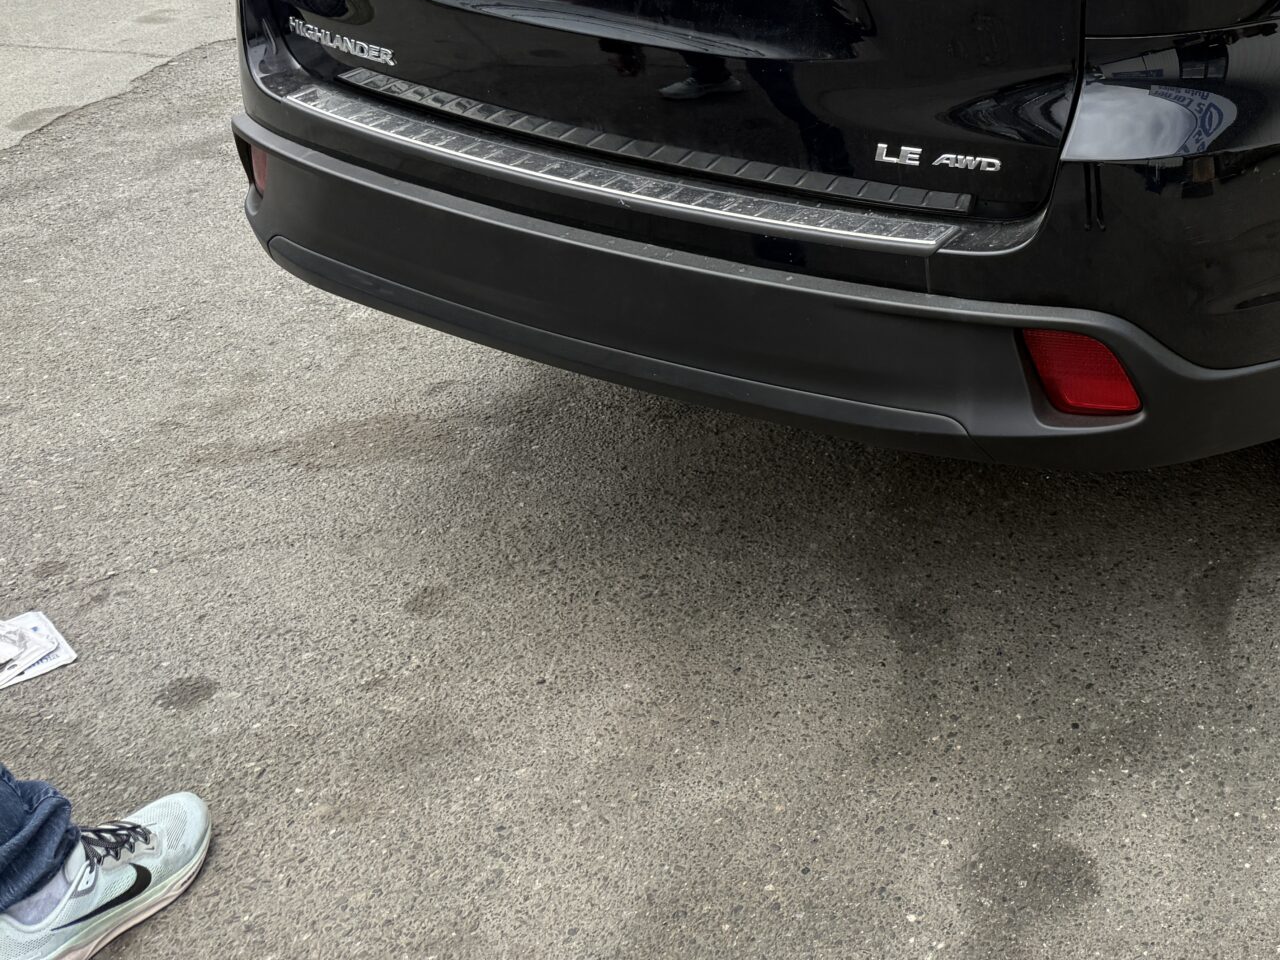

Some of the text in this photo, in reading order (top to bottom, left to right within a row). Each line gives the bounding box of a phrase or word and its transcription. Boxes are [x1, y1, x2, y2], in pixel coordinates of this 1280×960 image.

[288, 16, 397, 66] HIGHLANDER
[875, 143, 1002, 171] LE AWD
